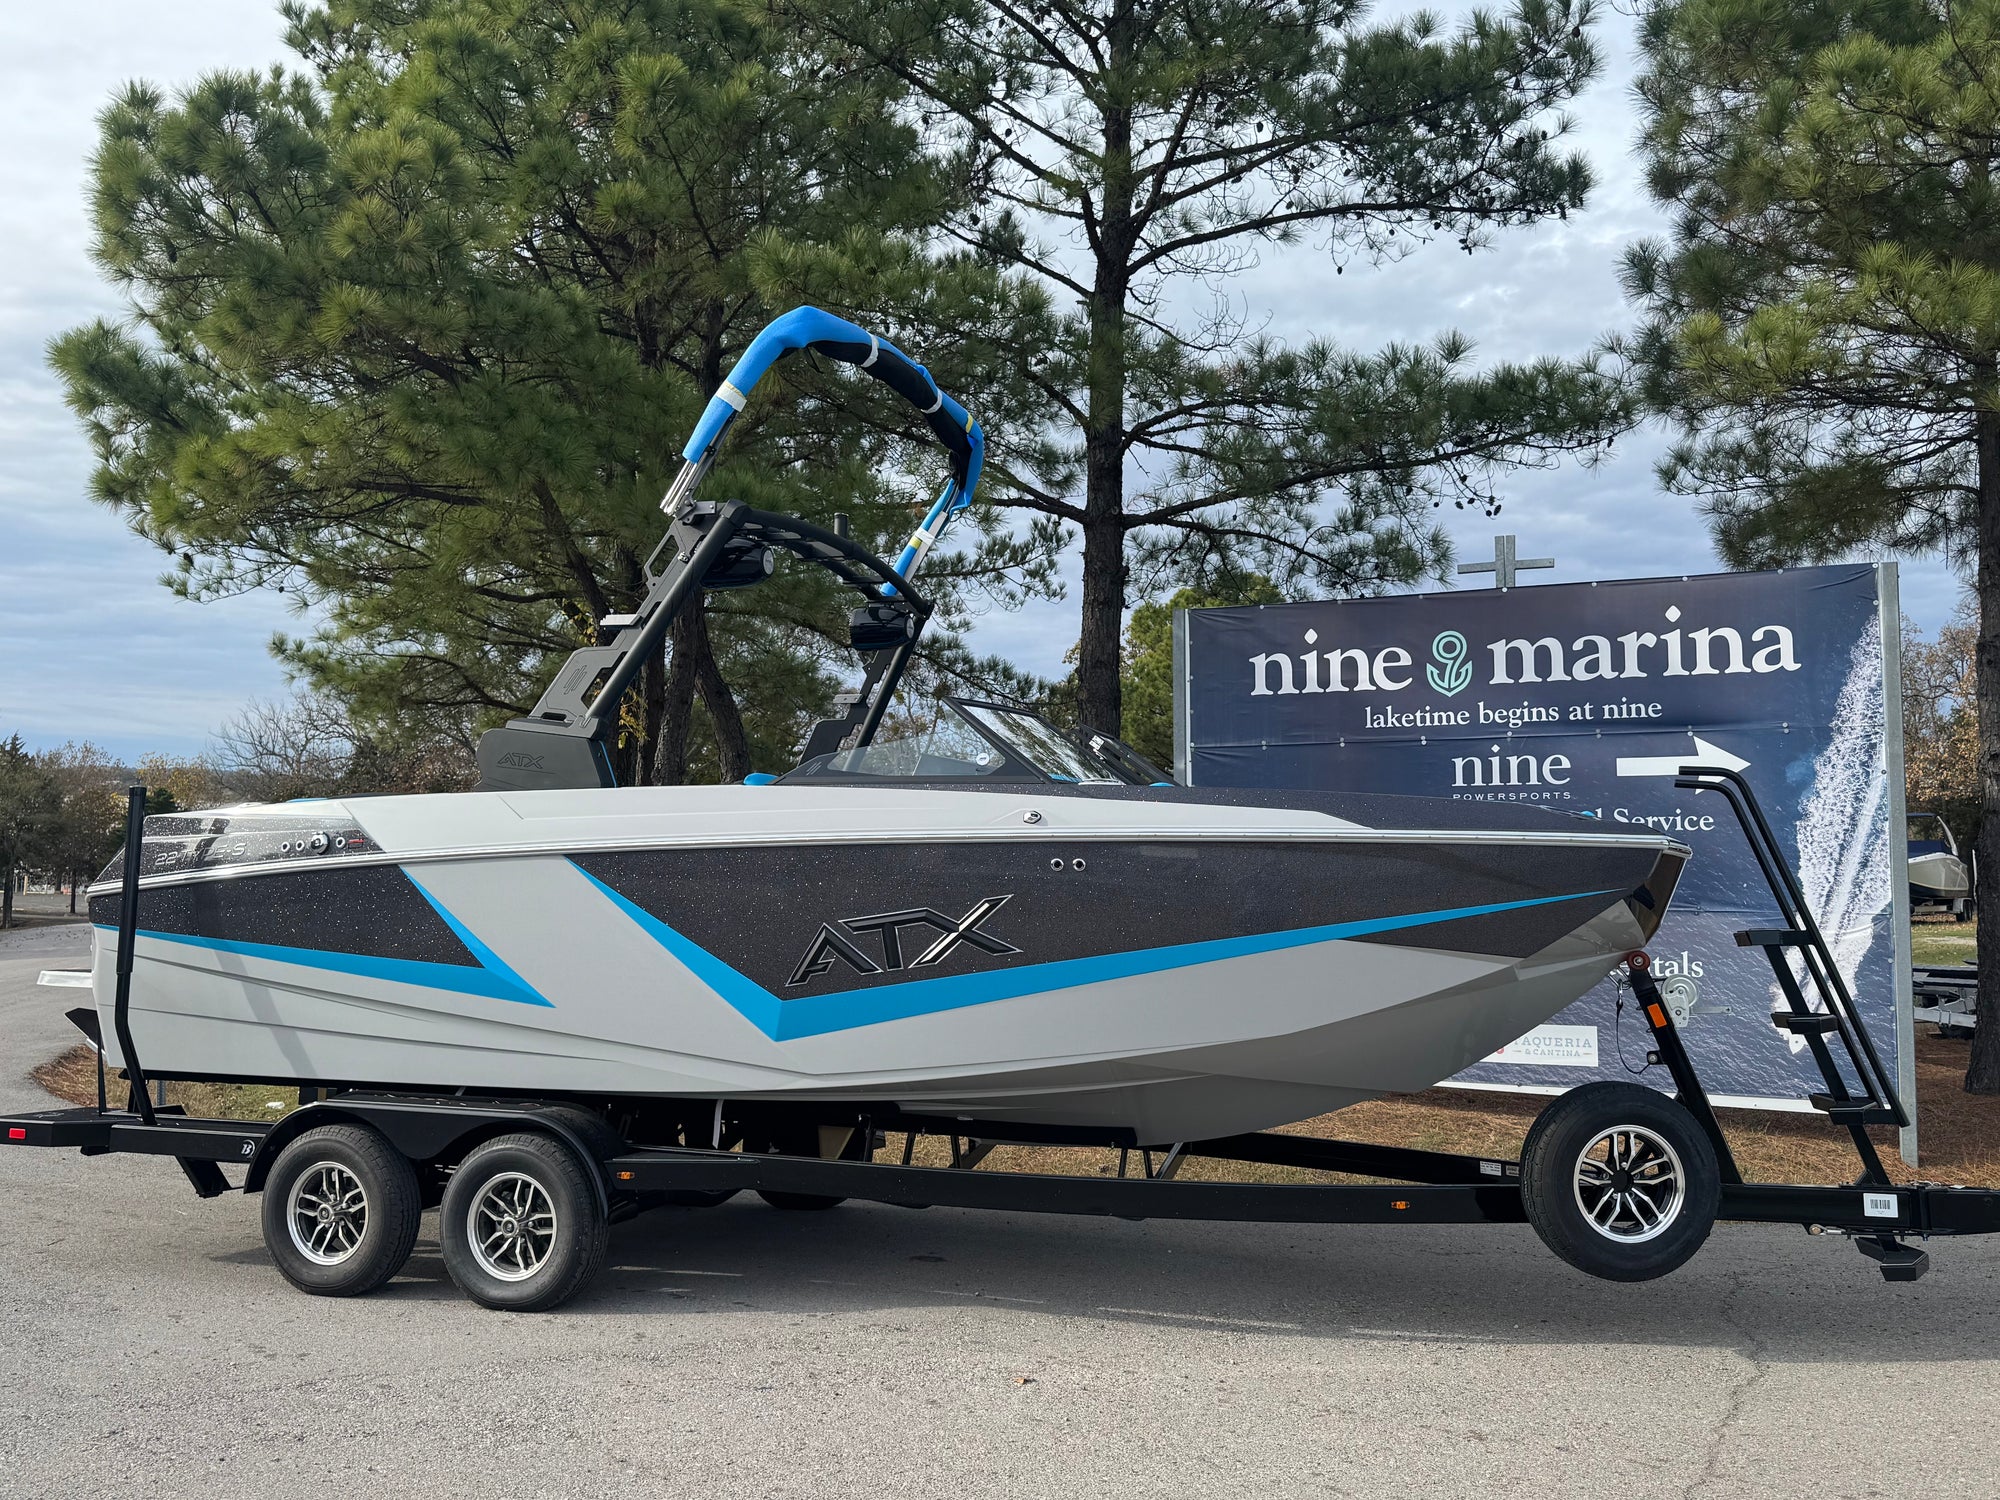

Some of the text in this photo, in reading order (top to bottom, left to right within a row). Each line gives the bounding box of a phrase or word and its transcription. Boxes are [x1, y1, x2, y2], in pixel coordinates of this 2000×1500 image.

[1248, 604, 1802, 696] nine marina
[1364, 696, 1663, 729] laketime begins at nine
[497, 752, 545, 770] ATX
[1451, 743, 1572, 787] nine
[1452, 791, 1571, 801] POWERSPORTS
[785, 894, 1024, 987] ATX
